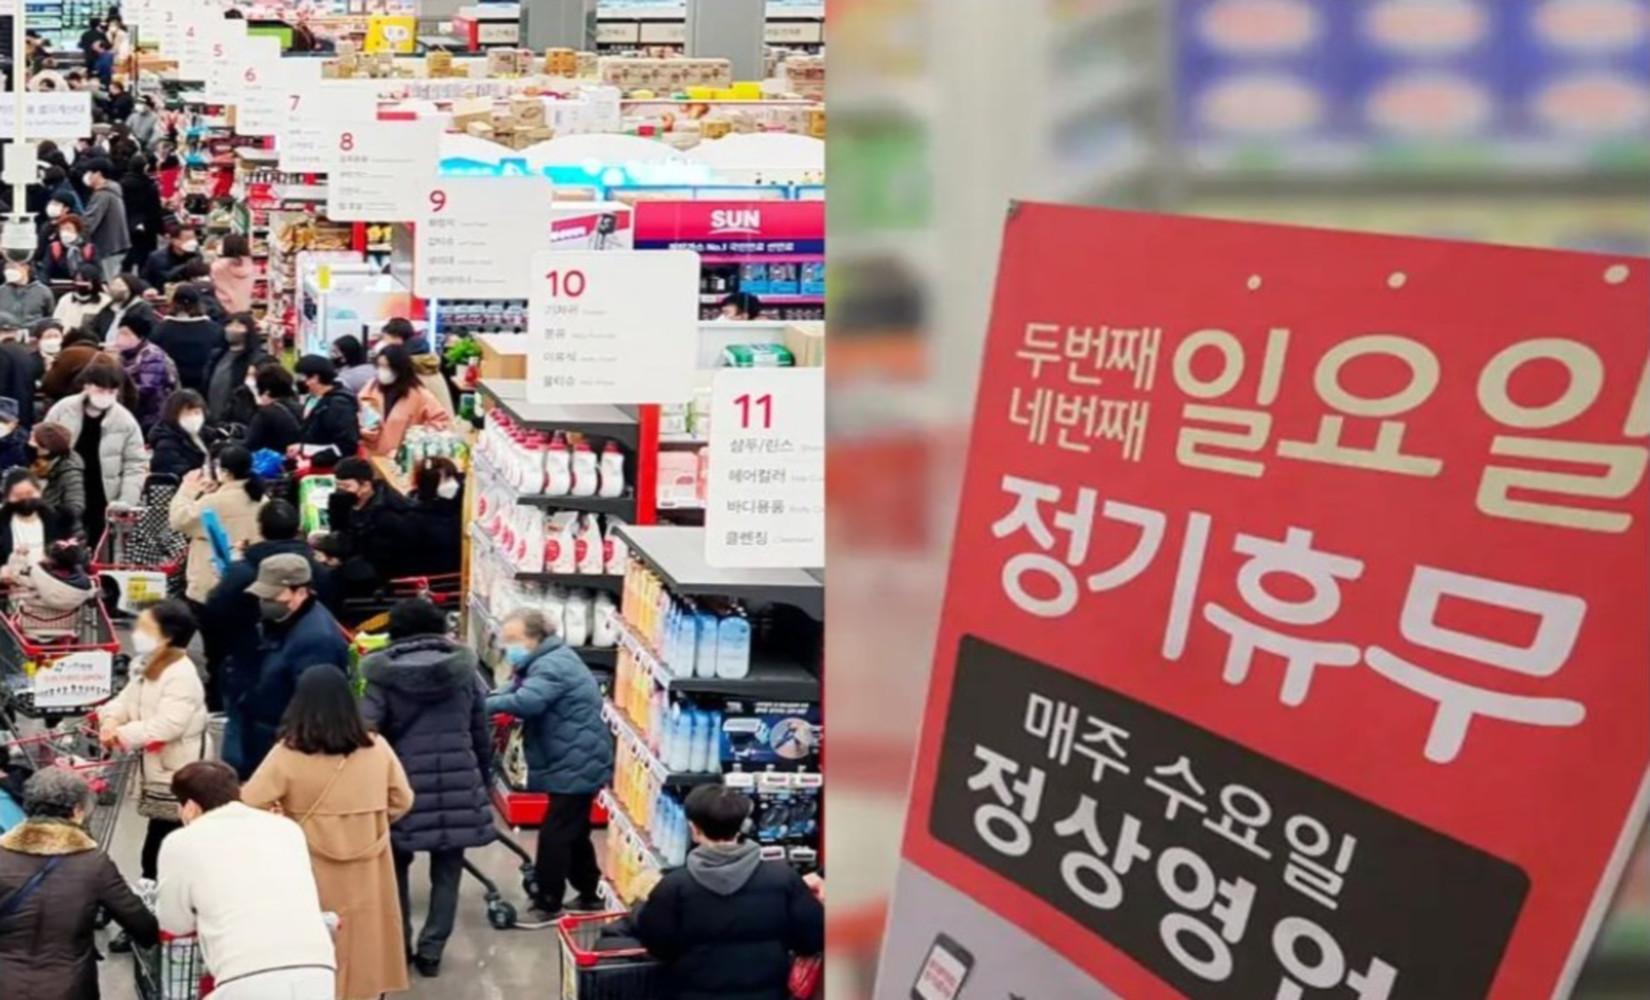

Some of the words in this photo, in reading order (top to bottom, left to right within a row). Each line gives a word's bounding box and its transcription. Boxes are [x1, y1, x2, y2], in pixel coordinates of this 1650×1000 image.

[165, 10, 174, 23] 3
[185, 26, 195, 38] 4
[213, 43, 223, 58] 5
[244, 67, 257, 83] 6
[289, 94, 301, 111] 7
[338, 131, 355, 152] 8
[428, 189, 447, 213] 9
[711, 209, 760, 228] SUN
[545, 269, 586, 298] 10
[1015, 323, 1162, 391] 두번째
[733, 393, 773, 429] 11
[1009, 387, 1149, 462] 네번째
[1173, 328, 1650, 533] 일요일
[730, 438, 794, 453] 샴푸/린스
[728, 468, 787, 483] 헤어컬러
[727, 499, 785, 514] 바디용품
[725, 531, 768, 546] 클렌징
[991, 475, 1587, 764] 정기휴무
[1024, 693, 1130, 783] 매주
[1145, 756, 1357, 909] 수요일
